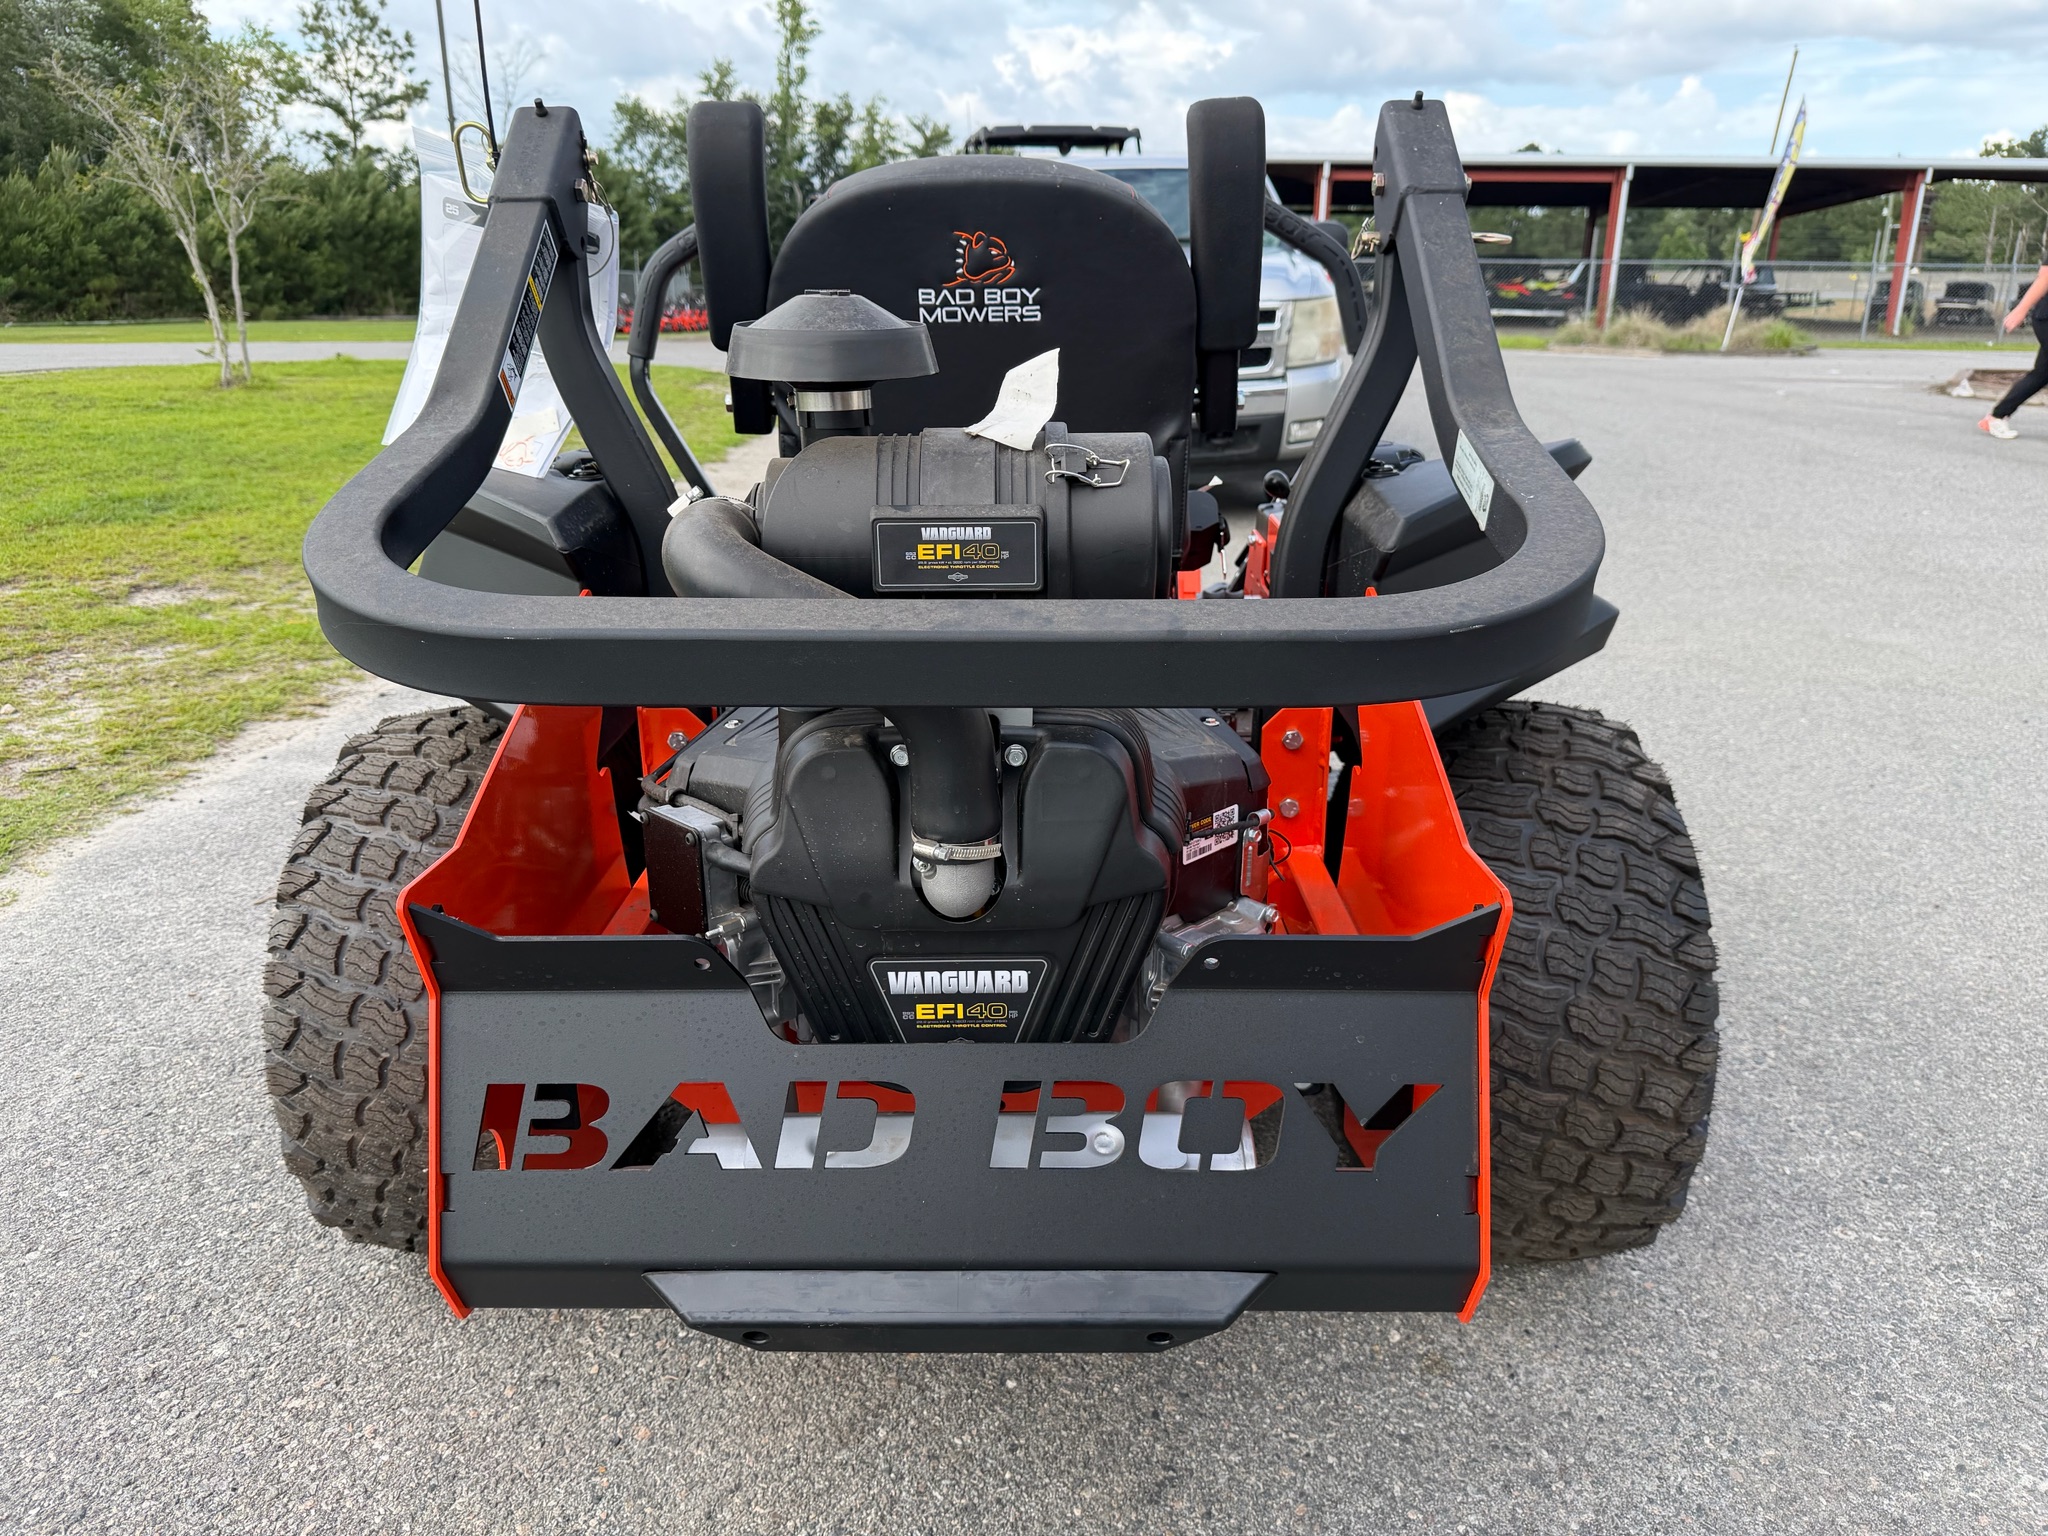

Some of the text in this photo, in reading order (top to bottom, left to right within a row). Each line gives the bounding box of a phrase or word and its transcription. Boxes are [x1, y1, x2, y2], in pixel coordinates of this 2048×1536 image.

[918, 287, 1041, 305] BAD BOY
[919, 305, 1042, 323] MOWERS
[921, 527, 992, 541] VANGUARD
[887, 970, 1029, 995] VANGUARD
[472, 1080, 1445, 1172] BAD BOY
